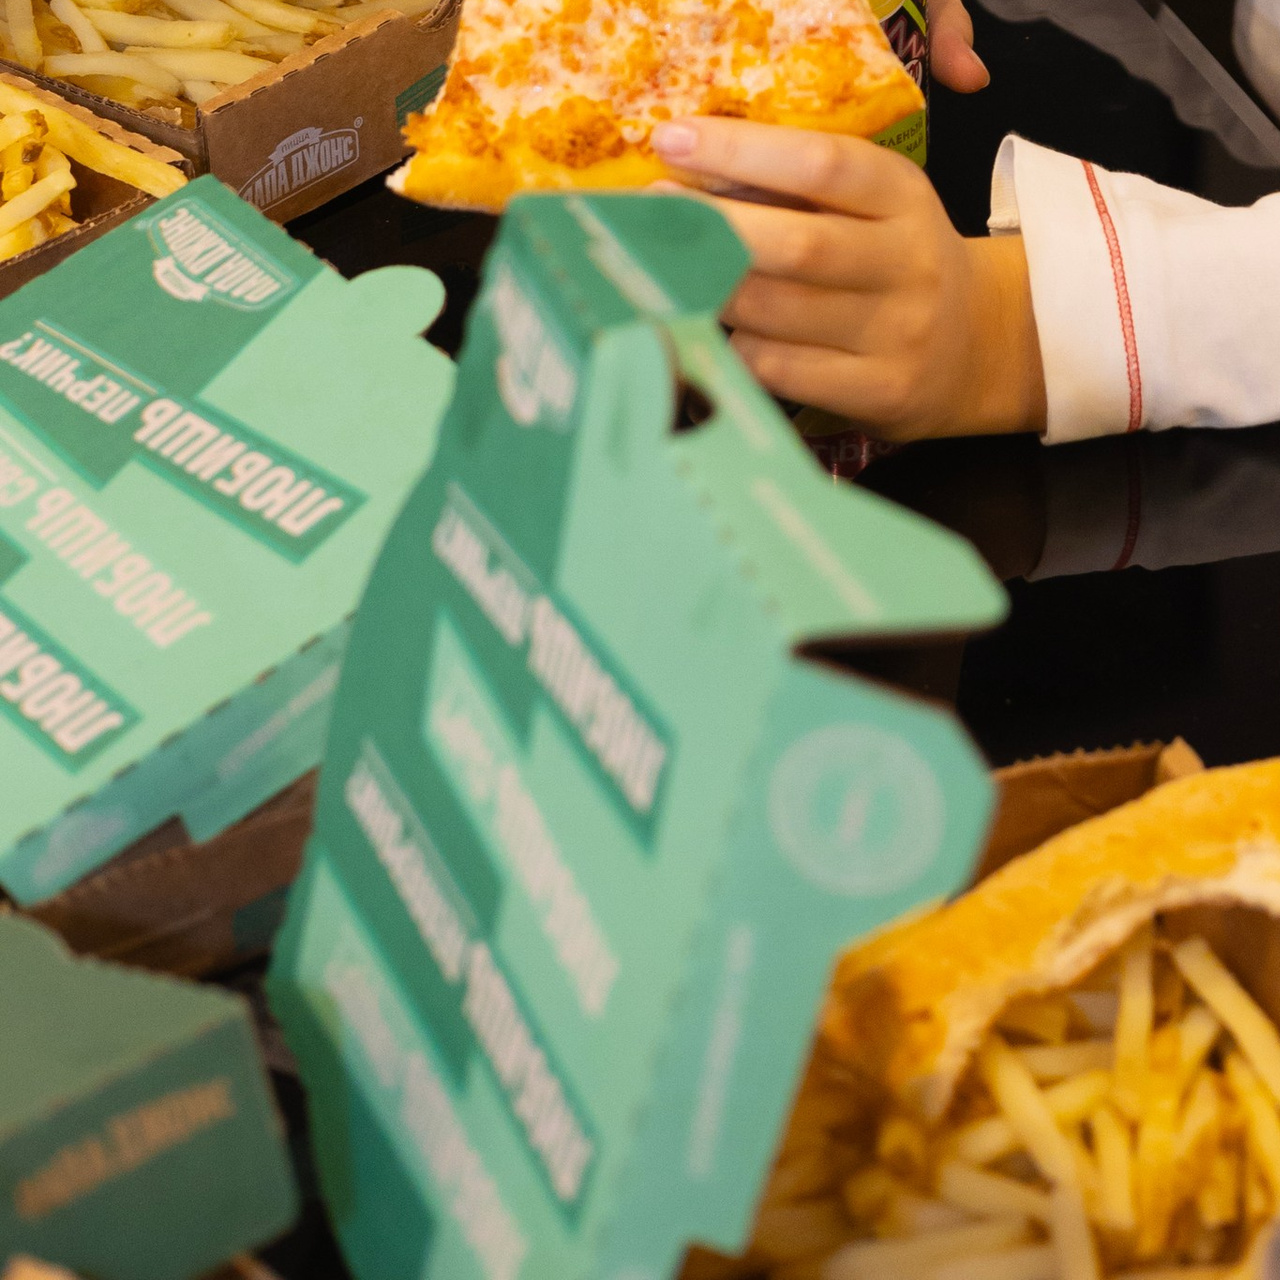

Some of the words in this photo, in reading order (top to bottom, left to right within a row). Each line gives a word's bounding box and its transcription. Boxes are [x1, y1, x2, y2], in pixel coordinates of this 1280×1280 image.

[291, 135, 354, 189] ДЖОНС
[874, 117, 923, 148] ЕЛЕНЫЙ
[158, 207, 236, 275] ДЖОНС
[203, 251, 281, 302] ПАПА
[0, 332, 141, 424] ПЕРЧИК?
[133, 397, 344, 537] ЛЮБИШЬ
[24, 487, 212, 649] ЛЮБИШЬ
[0, 611, 124, 755] ЛЮБИ
